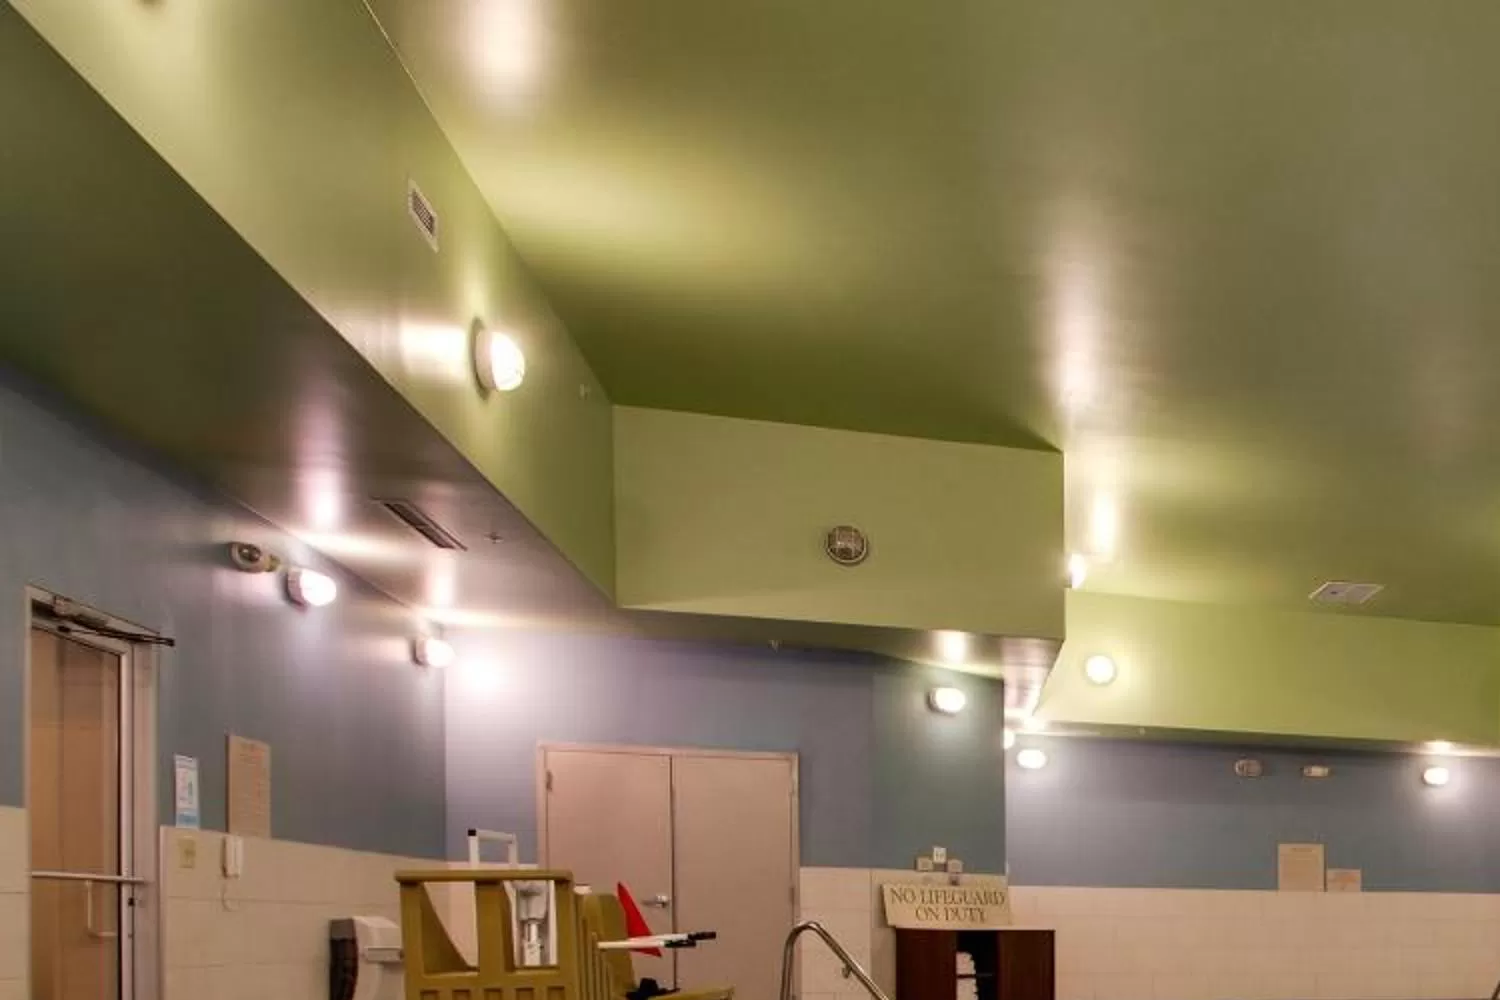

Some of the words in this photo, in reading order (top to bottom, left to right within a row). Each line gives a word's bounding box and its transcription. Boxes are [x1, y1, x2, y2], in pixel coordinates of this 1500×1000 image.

[889, 887, 916, 905] NO
[920, 888, 1005, 906] LIFEGUARD
[915, 906, 940, 921] ON
[943, 907, 985, 923] DUTY
